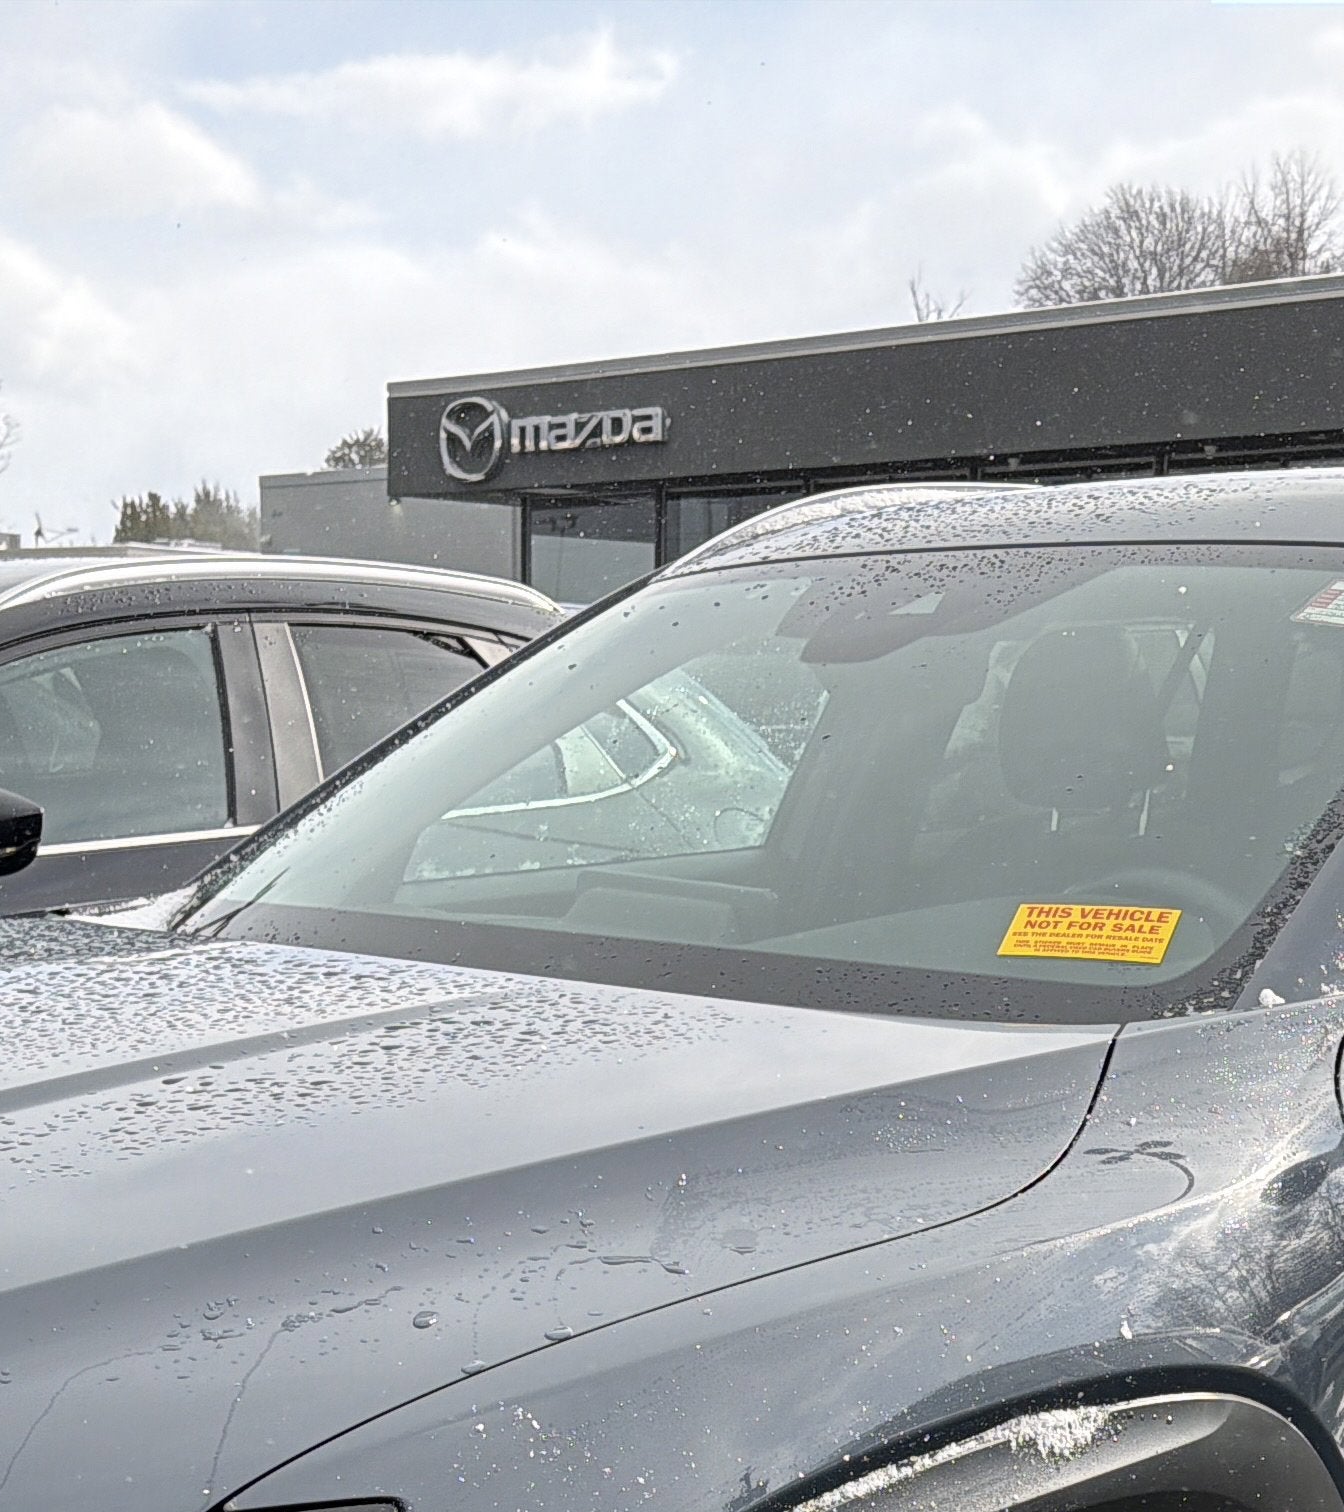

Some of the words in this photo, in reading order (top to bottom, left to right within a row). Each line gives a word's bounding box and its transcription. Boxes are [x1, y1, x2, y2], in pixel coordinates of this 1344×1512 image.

[510, 406, 665, 453] mazda
[1026, 906, 1074, 919] THIS
[1080, 907, 1173, 924] VEHICLE
[1023, 919, 1063, 930] NOT
[1066, 920, 1106, 932] FOR
[1110, 922, 1163, 935] SALE
